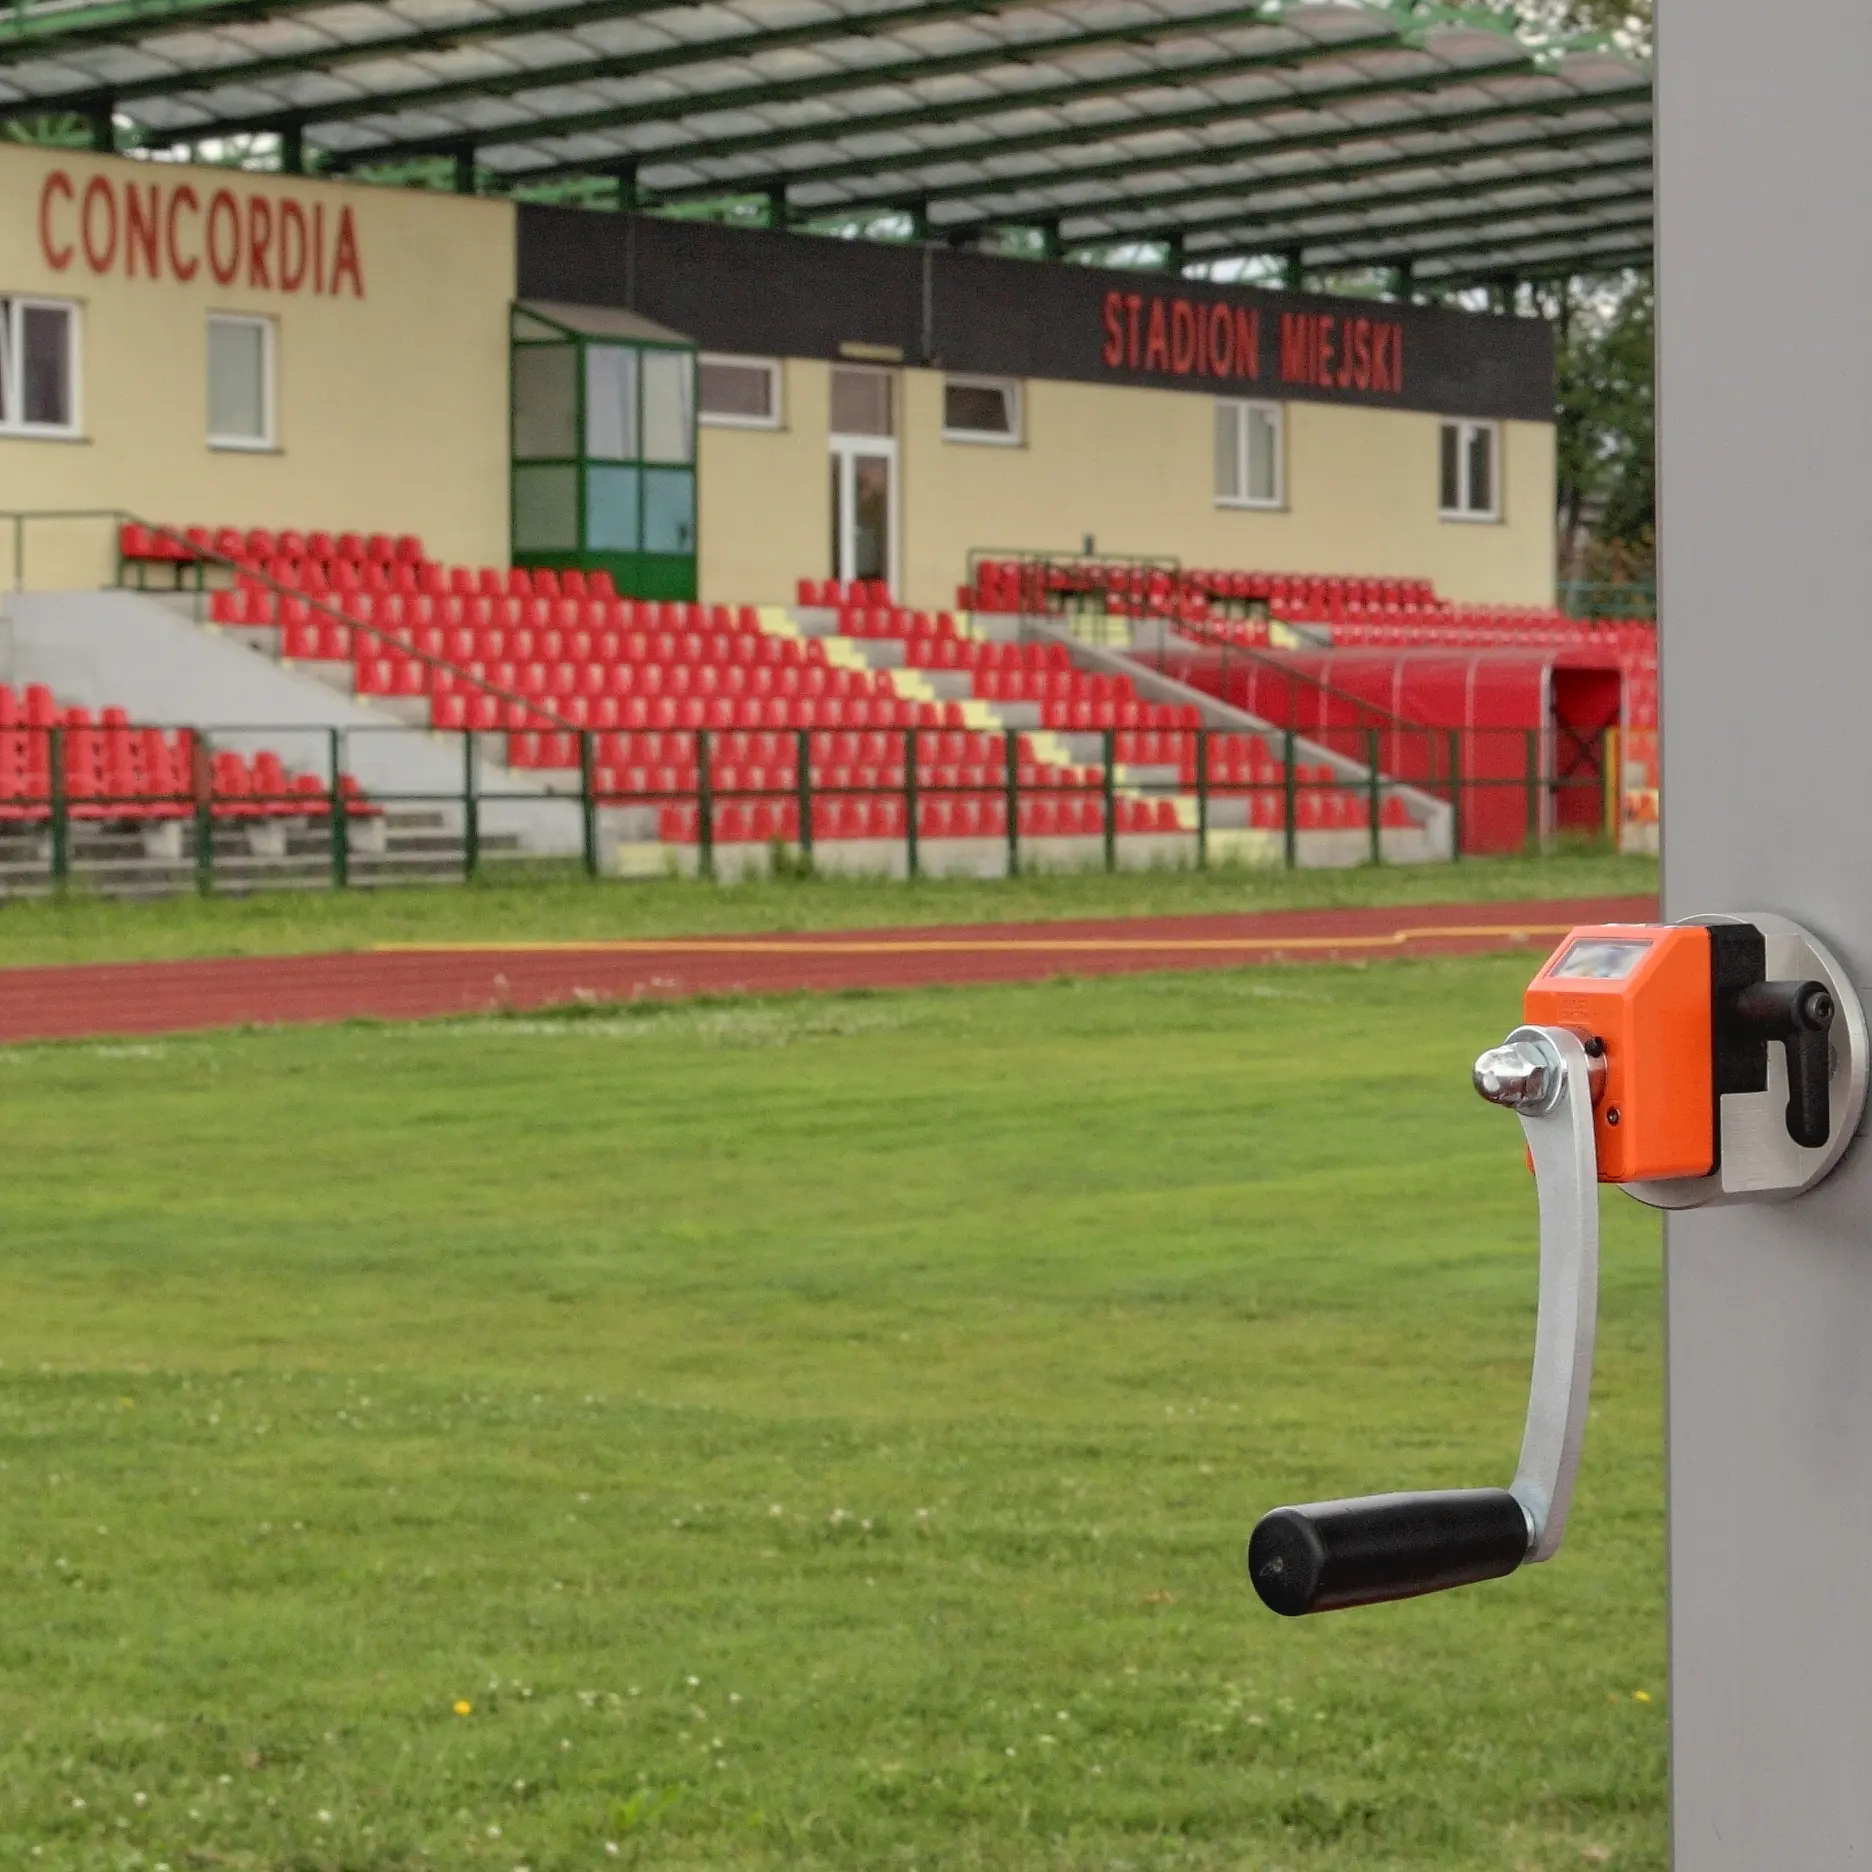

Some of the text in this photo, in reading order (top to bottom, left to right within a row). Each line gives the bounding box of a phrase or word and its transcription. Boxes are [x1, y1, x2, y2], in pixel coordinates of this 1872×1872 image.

[38, 168, 366, 300] CONCORDIA
[1101, 289, 1403, 393] STADION MIEJSKI
